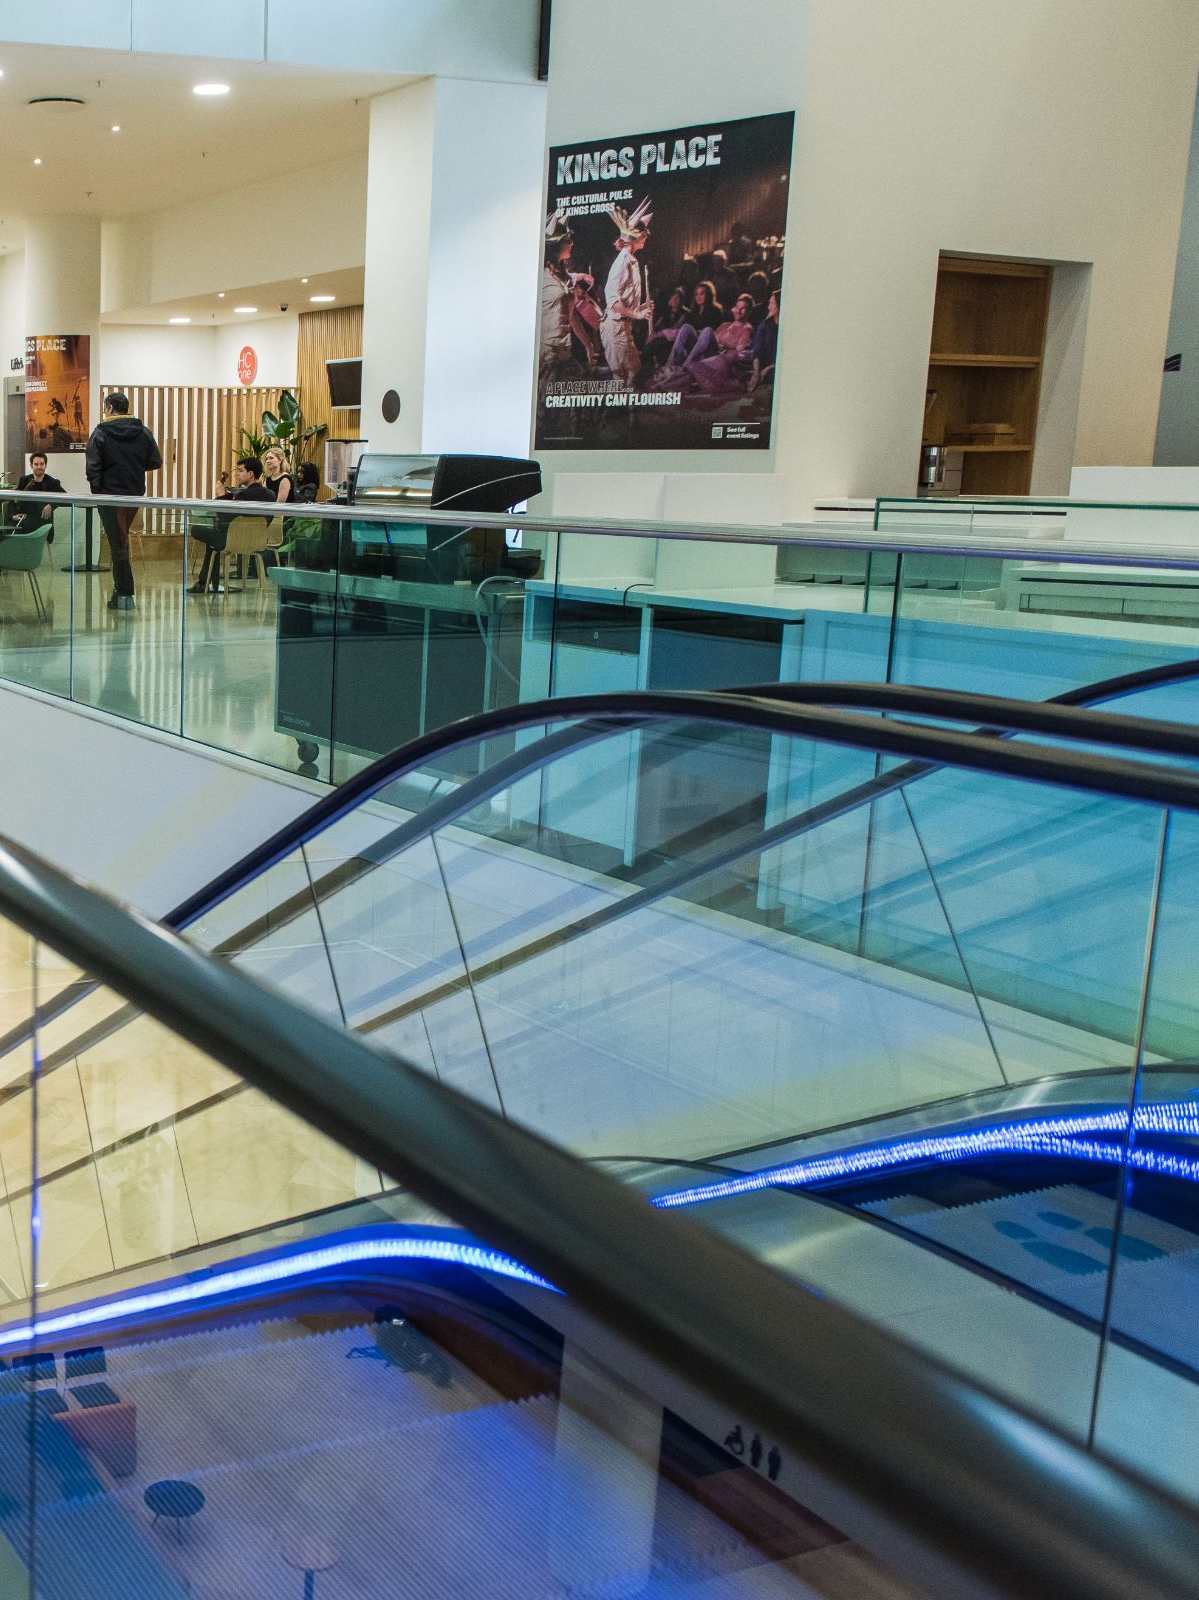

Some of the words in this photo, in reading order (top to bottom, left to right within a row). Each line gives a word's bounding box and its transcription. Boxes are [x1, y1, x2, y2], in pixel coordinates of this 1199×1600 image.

[556, 147, 635, 185] KINGS
[639, 134, 723, 175] PLACE
[556, 196, 571, 208] THE
[571, 191, 608, 206] CULTURAL
[609, 189, 633, 201] PULSE
[556, 207, 565, 217] OF
[566, 205, 589, 217] KINGS
[590, 203, 615, 214] CROSS
[36, 339, 67, 351] PLACE
[546, 381, 554, 394] A
[554, 381, 586, 394] PLACE
[545, 395, 603, 408] CREATIVITY
[605, 394, 627, 407] CAN
[628, 392, 681, 406] FLOURISH
